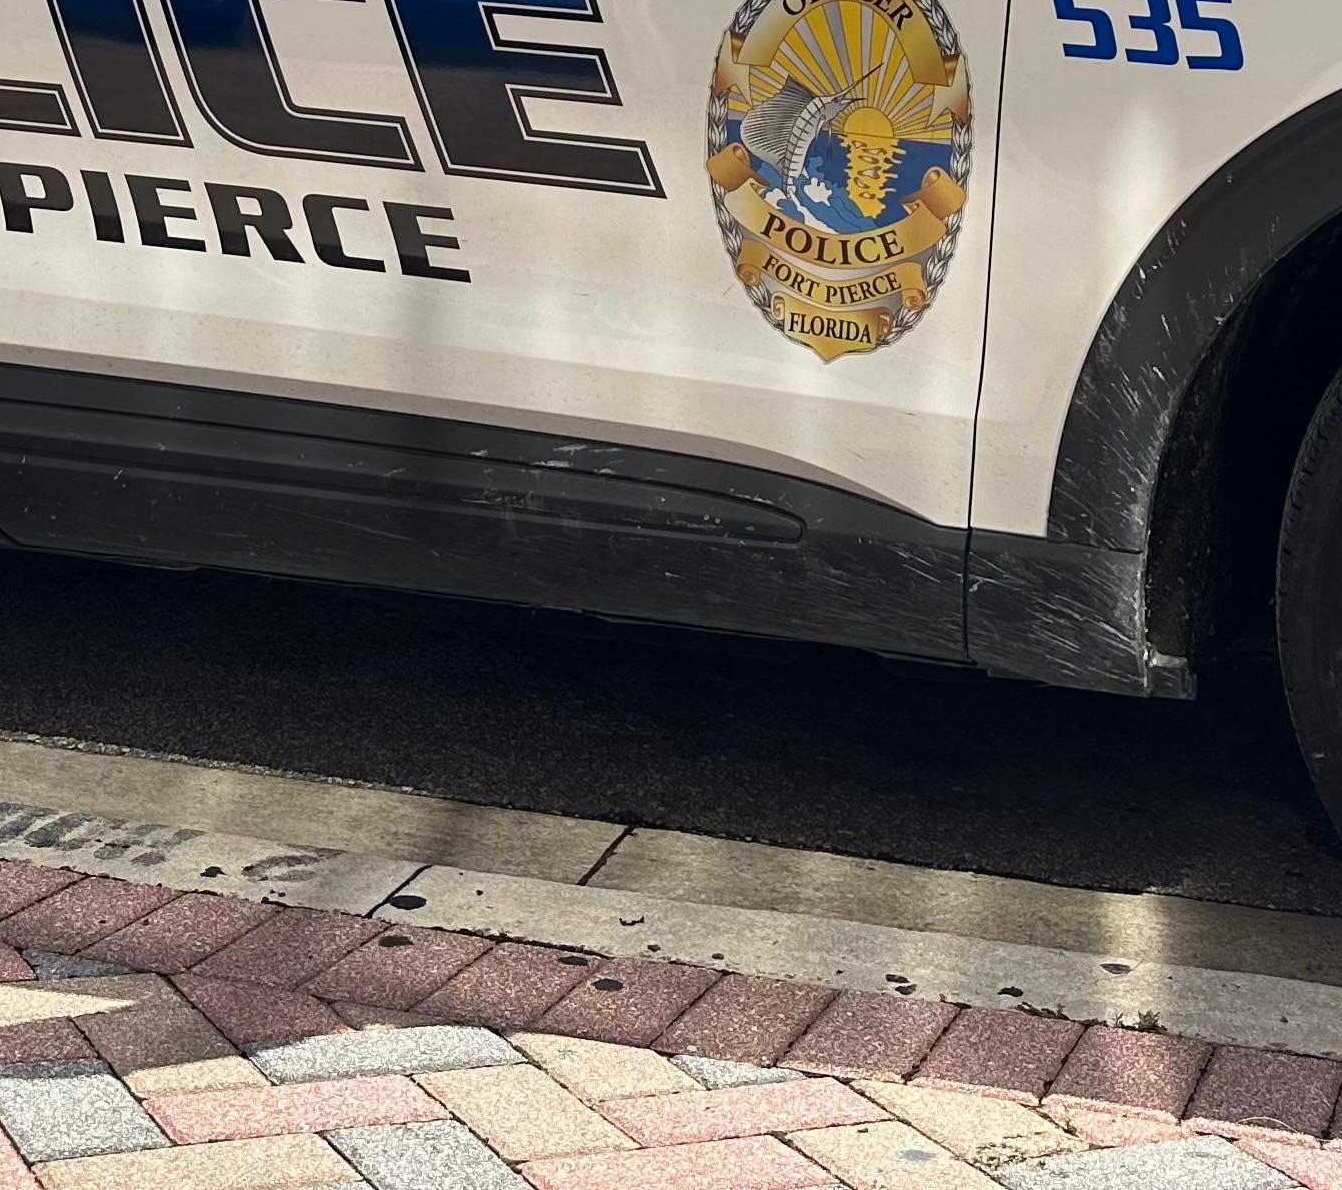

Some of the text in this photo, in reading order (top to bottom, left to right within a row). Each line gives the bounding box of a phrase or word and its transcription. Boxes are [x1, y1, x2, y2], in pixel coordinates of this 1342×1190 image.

[759, 212, 904, 266] POLICE
[762, 254, 902, 305] FORT PIERCE
[788, 312, 873, 345] FLORIDA
